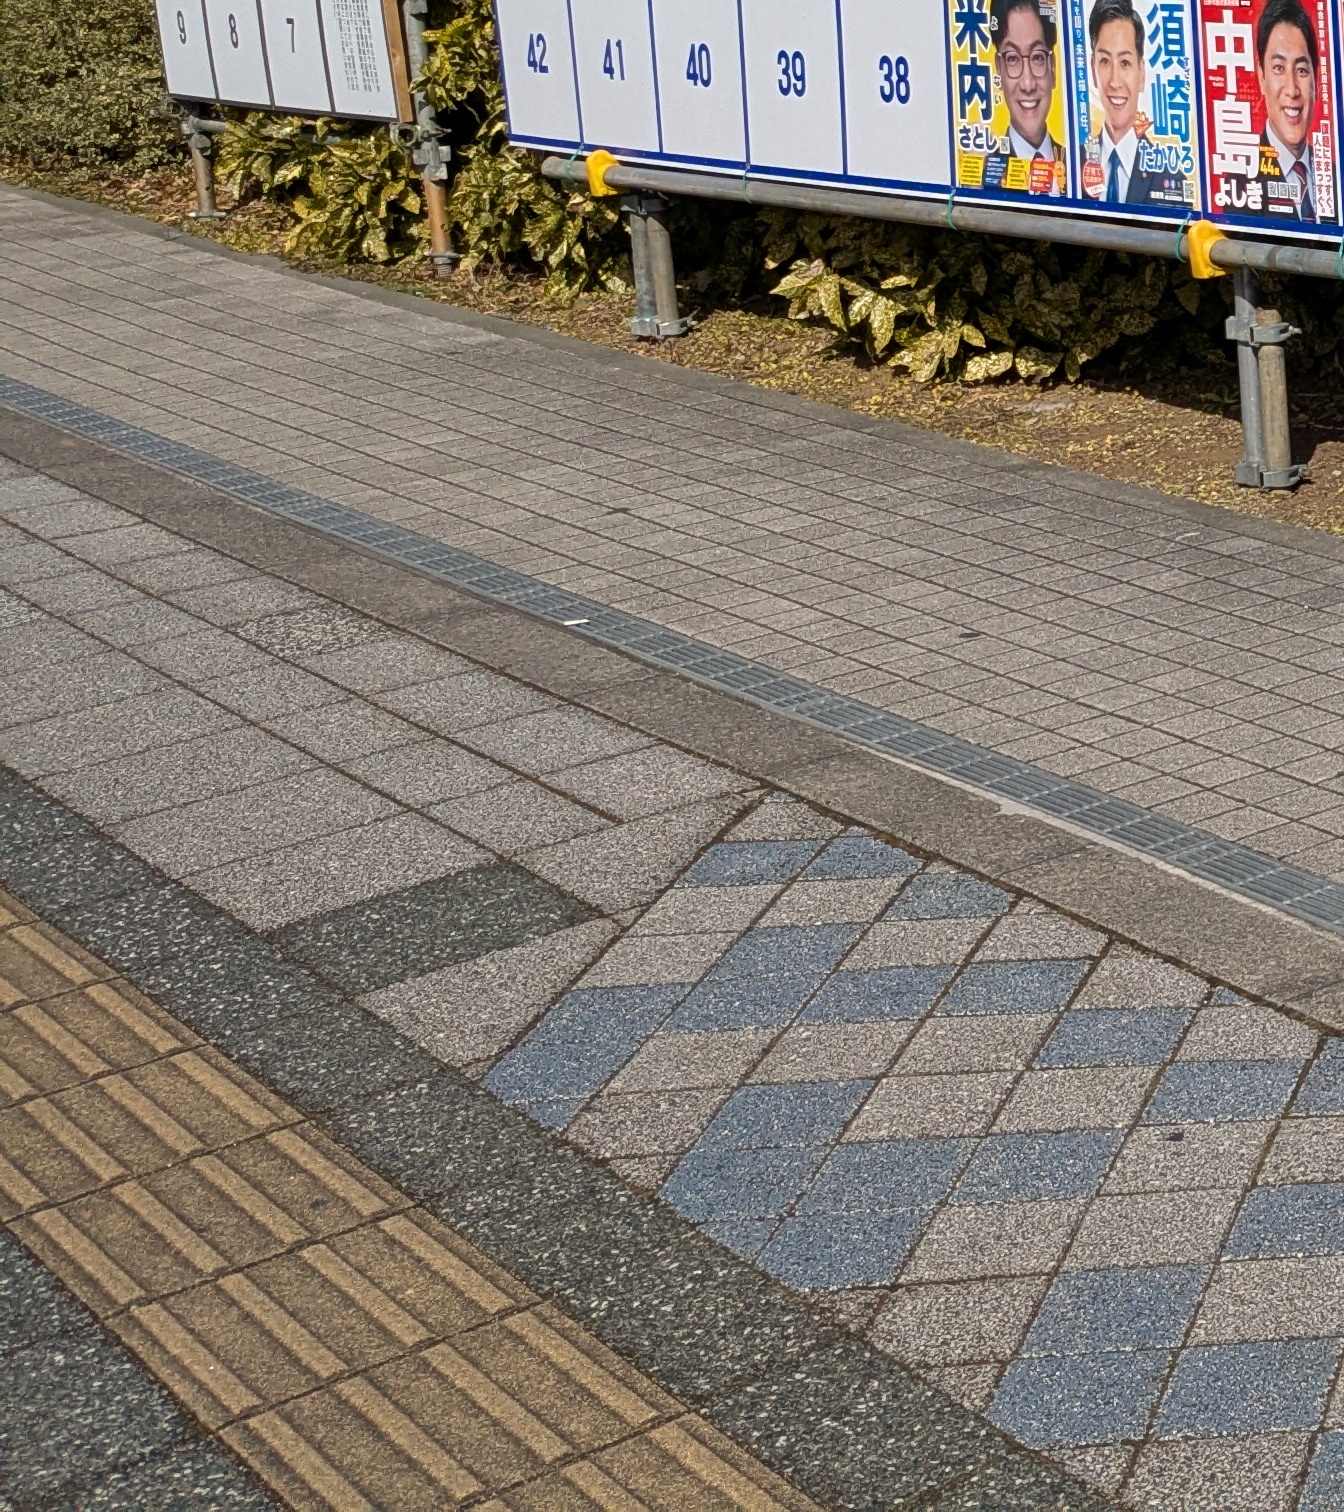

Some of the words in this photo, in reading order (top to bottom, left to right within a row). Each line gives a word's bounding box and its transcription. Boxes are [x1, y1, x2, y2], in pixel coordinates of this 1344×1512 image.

[176, 9, 187, 45] 9
[228, 13, 240, 49] 8
[286, 17, 296, 53] 7
[527, 32, 550, 75] 42
[603, 37, 626, 82] 41
[685, 42, 712, 88] 40
[776, 48, 806, 98] 39
[1146, 2, 1191, 144] 須崎
[877, 54, 911, 105] 38
[1204, 9, 1261, 180] 中島
[958, 125, 998, 152] さとし
[1139, 139, 1195, 175] たかひろ
[1214, 178, 1264, 210] よしき
